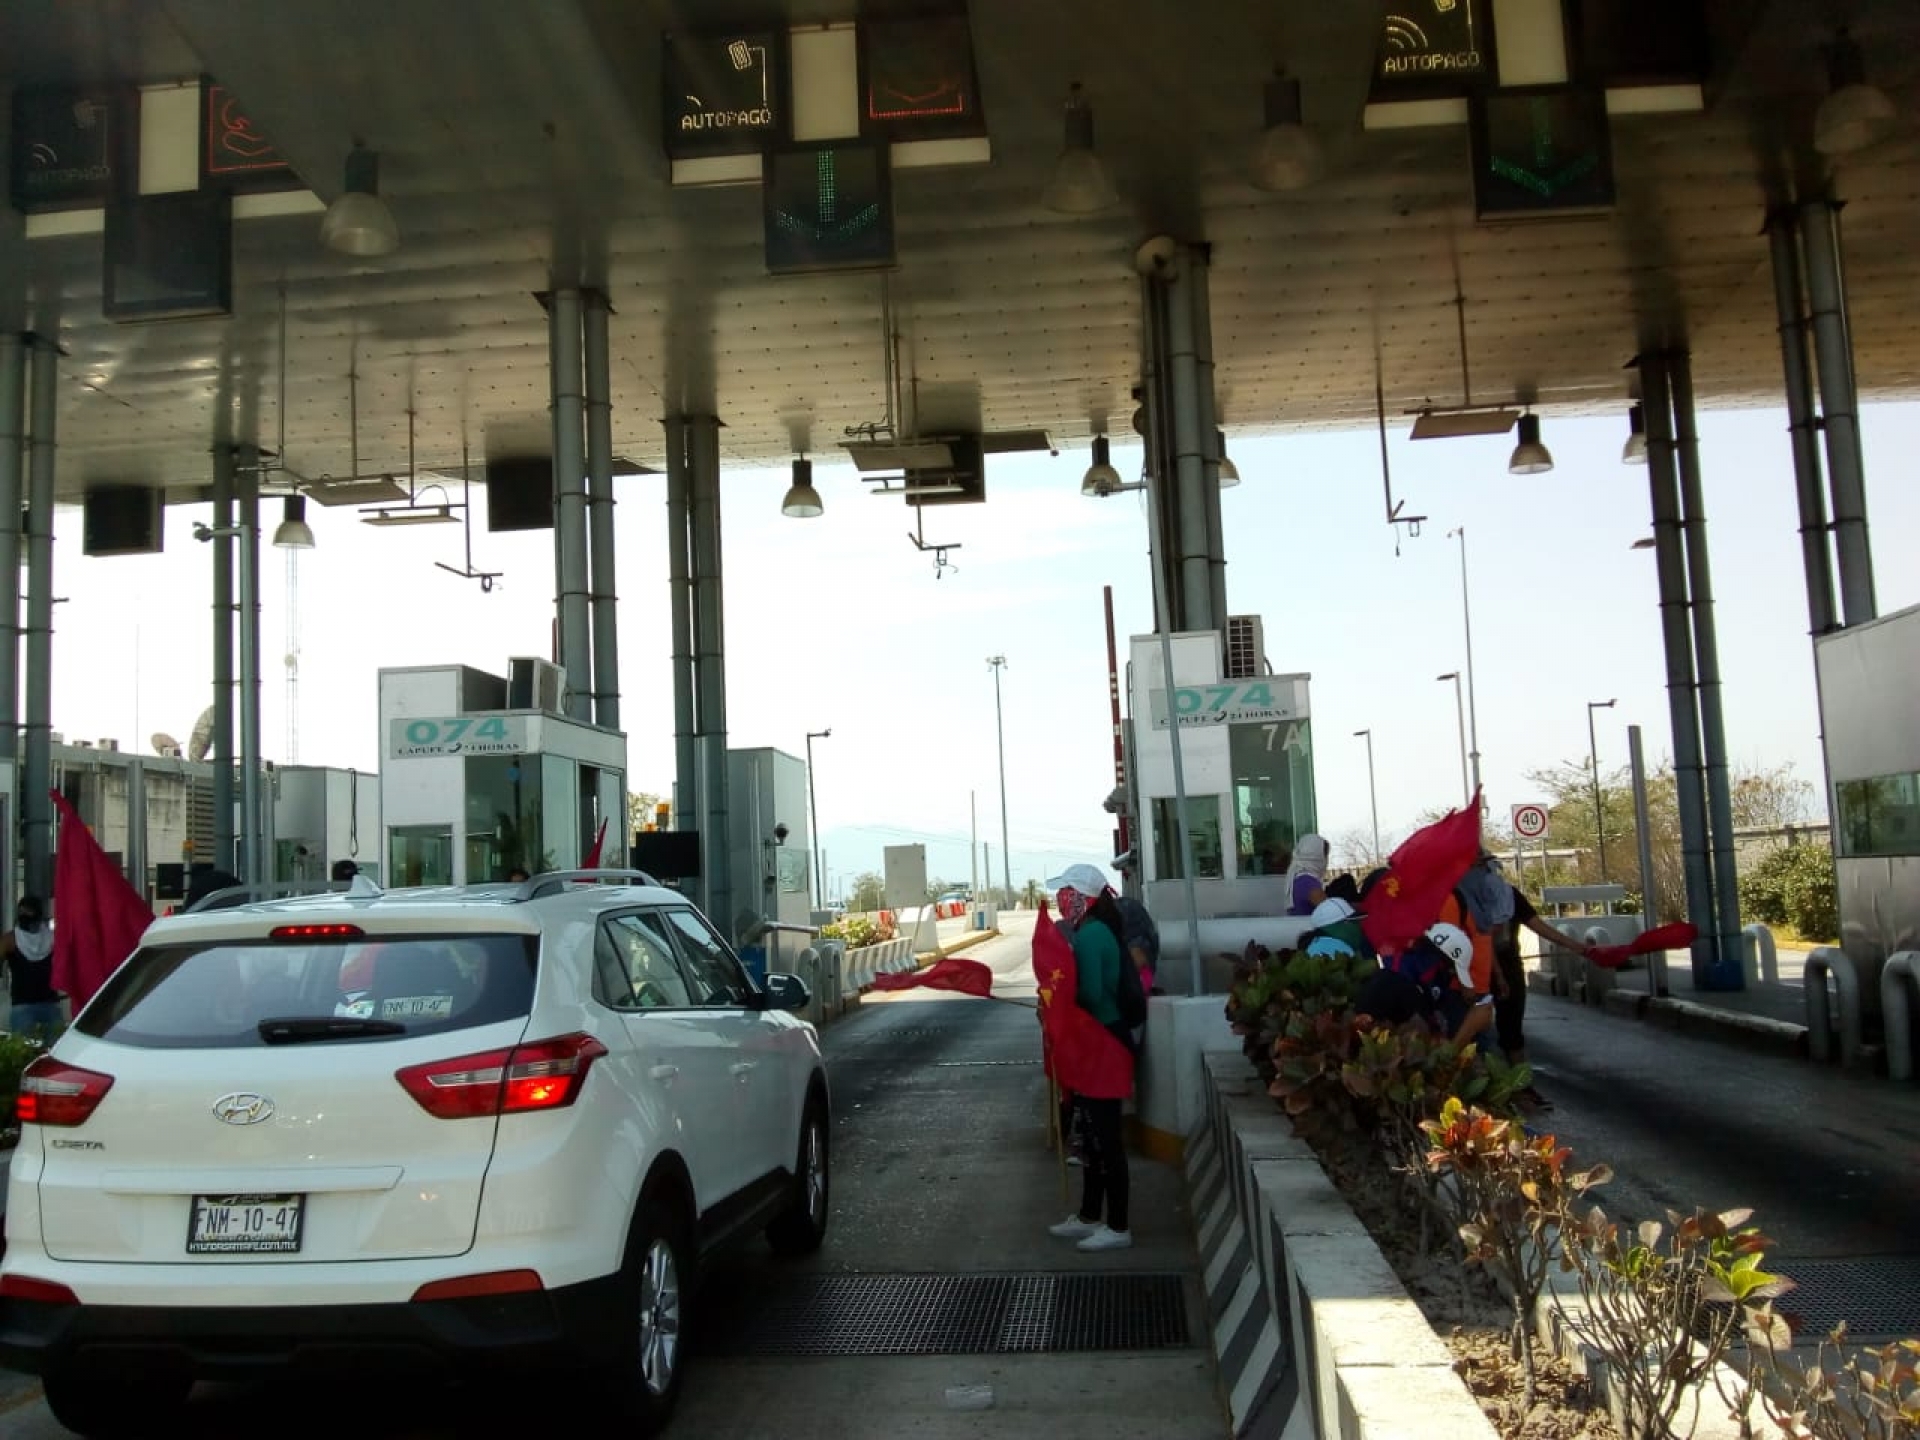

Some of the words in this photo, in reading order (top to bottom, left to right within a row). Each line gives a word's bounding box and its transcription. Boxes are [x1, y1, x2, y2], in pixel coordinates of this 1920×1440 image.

[1385, 51, 1480, 73] AUTOPAGO
[682, 108, 771, 130] AUTOPAGO
[1174, 682, 1275, 715] 074
[406, 717, 508, 745] 074
[1160, 714, 1207, 726] CPUFE
[1522, 812, 1538, 826] 40
[195, 1207, 299, 1235] FNM-10-47
